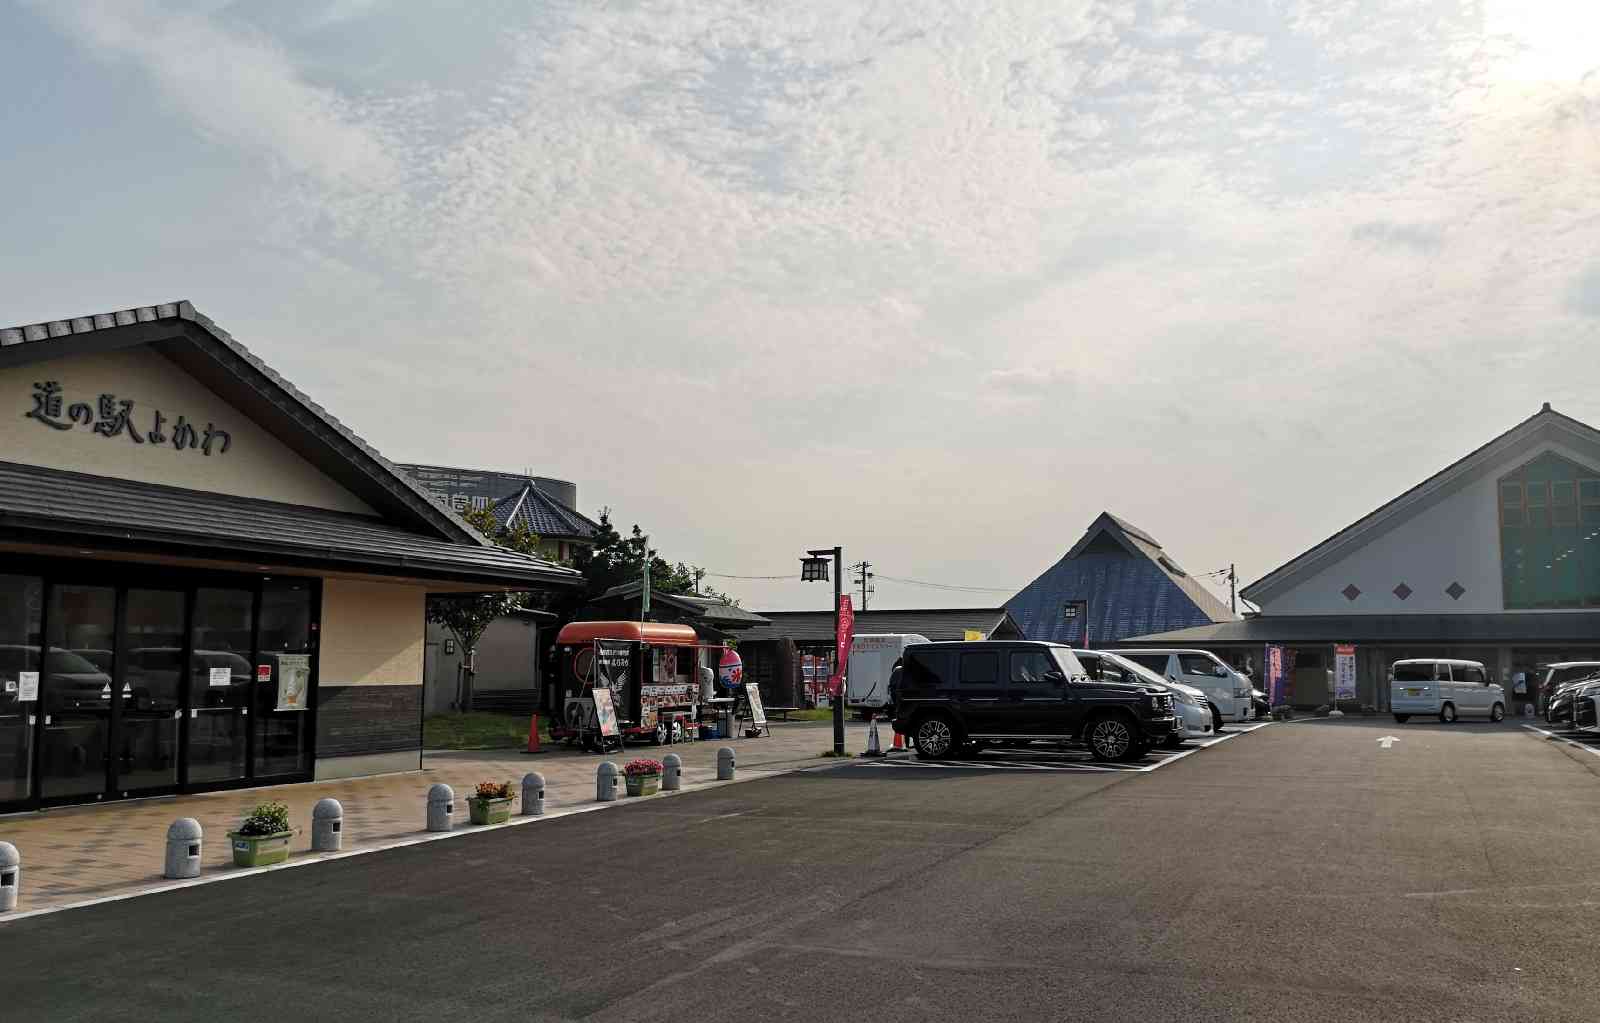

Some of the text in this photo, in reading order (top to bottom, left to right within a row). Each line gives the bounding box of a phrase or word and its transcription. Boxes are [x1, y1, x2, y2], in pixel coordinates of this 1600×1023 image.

[25, 381, 231, 456] 道の駅よかわ
